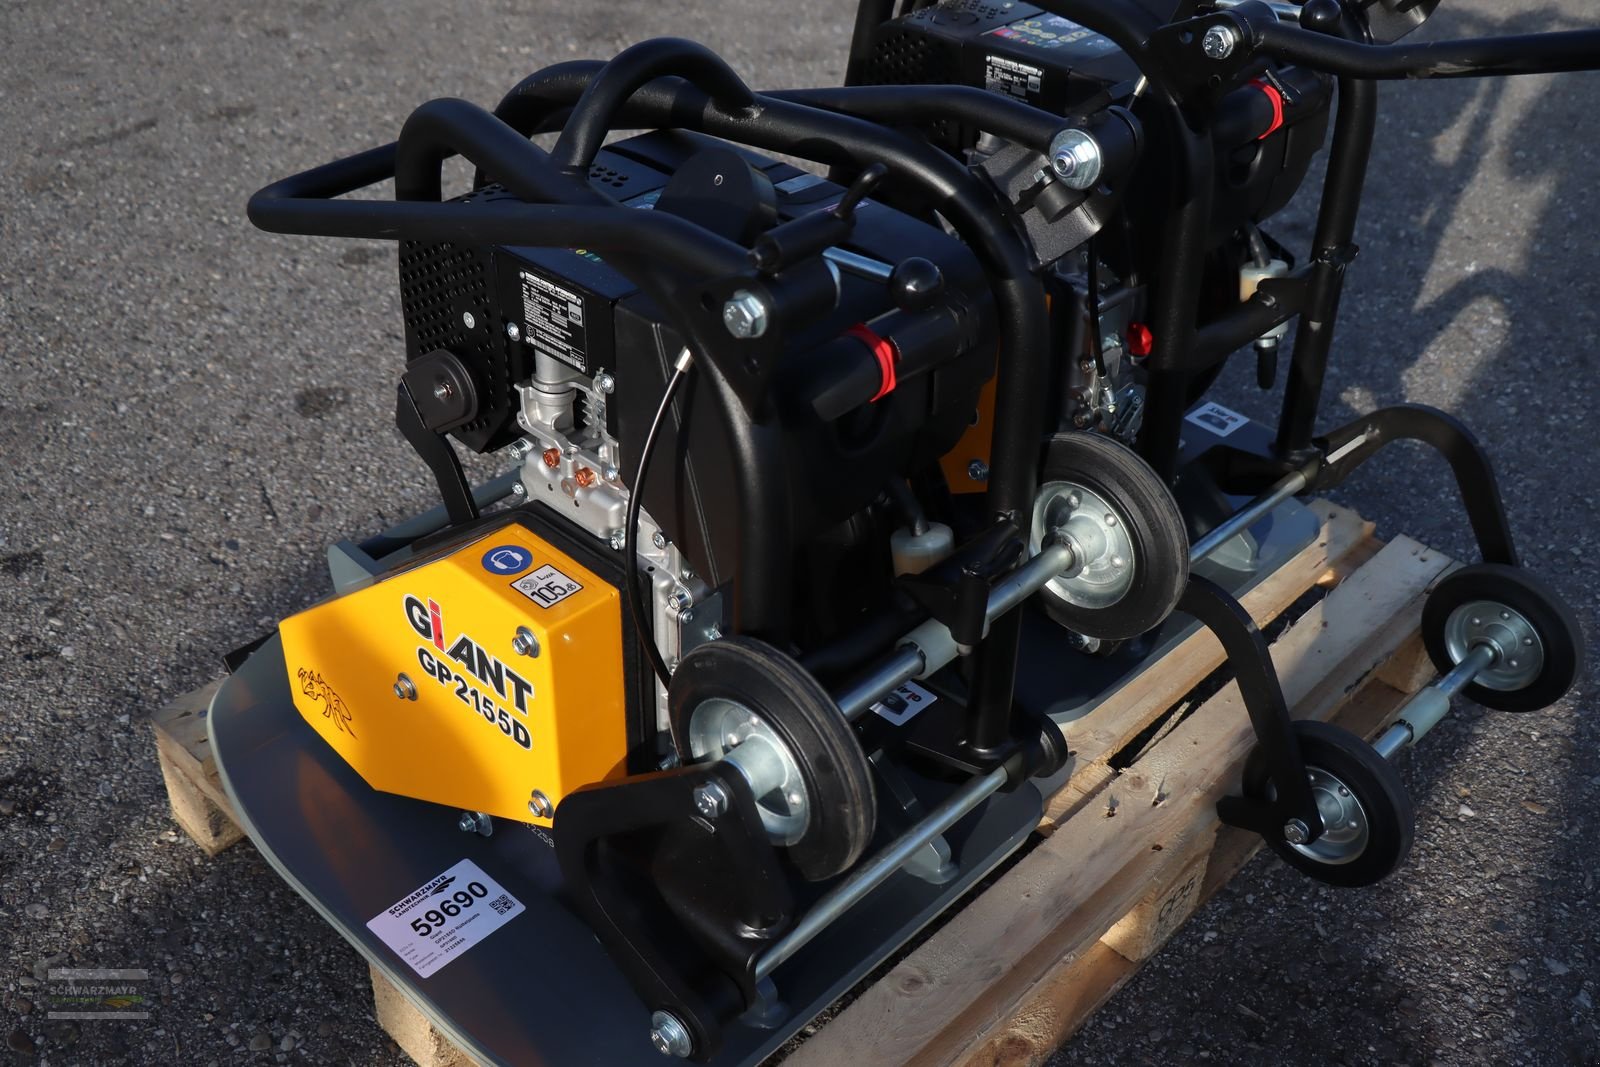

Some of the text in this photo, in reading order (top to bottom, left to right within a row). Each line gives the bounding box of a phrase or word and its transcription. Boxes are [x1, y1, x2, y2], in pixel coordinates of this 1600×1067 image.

[531, 581, 568, 604] 105
[417, 646, 532, 750] GP2155D
[388, 875, 448, 916] SCHWARZMAYR
[394, 894, 431, 919] LANDTECHNIK
[410, 881, 488, 937] 59690
